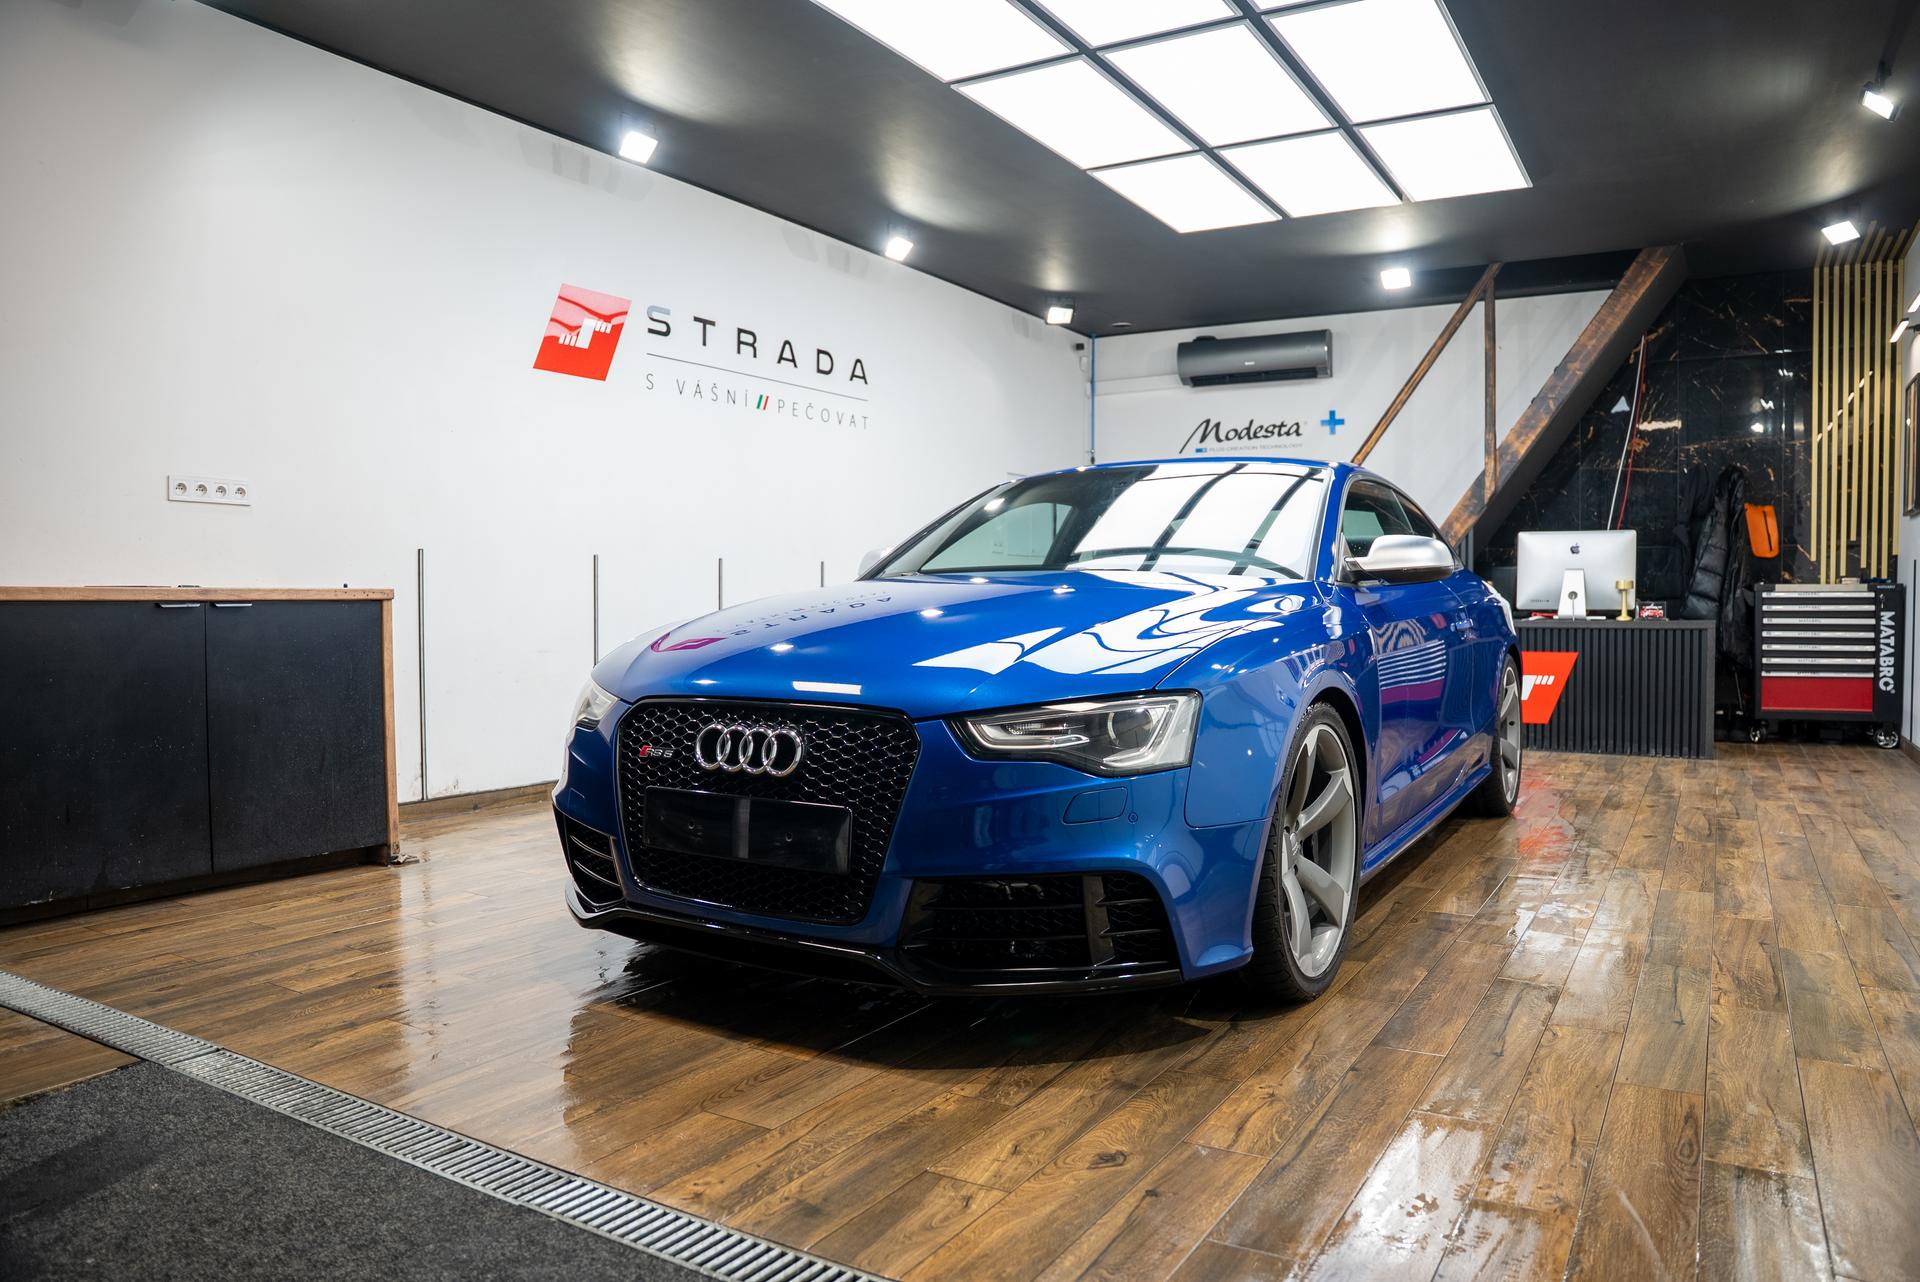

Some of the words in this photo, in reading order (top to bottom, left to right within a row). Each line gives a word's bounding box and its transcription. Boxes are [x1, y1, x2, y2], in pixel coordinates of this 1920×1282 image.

[646, 304, 869, 385] STRADA
[645, 373, 655, 391] S
[777, 398, 870, 430] PEČOVAT
[1179, 418, 1303, 454] Modesta
[1879, 611, 1896, 691] MATABRO
